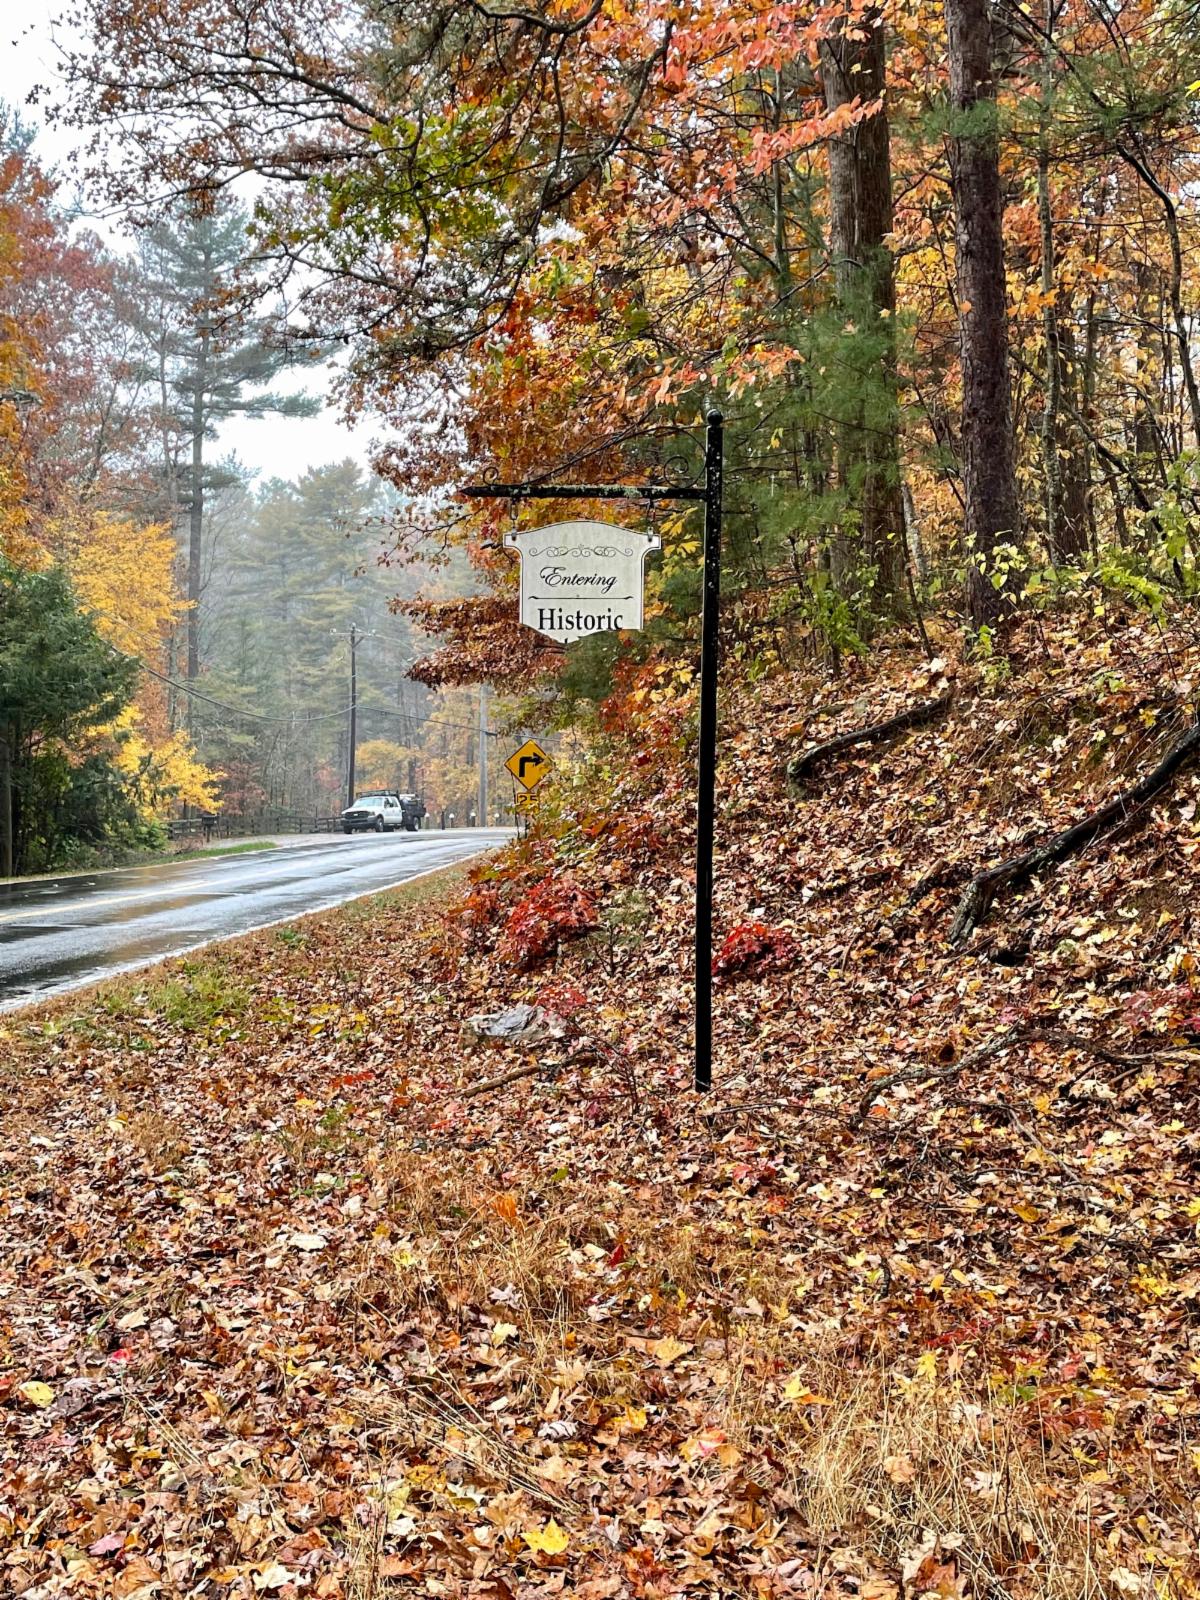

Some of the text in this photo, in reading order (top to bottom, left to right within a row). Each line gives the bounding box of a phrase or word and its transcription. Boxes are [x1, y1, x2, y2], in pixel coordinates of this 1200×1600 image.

[540, 566, 617, 594] Entering
[537, 607, 623, 631] Historic
[519, 795, 538, 805] 25
